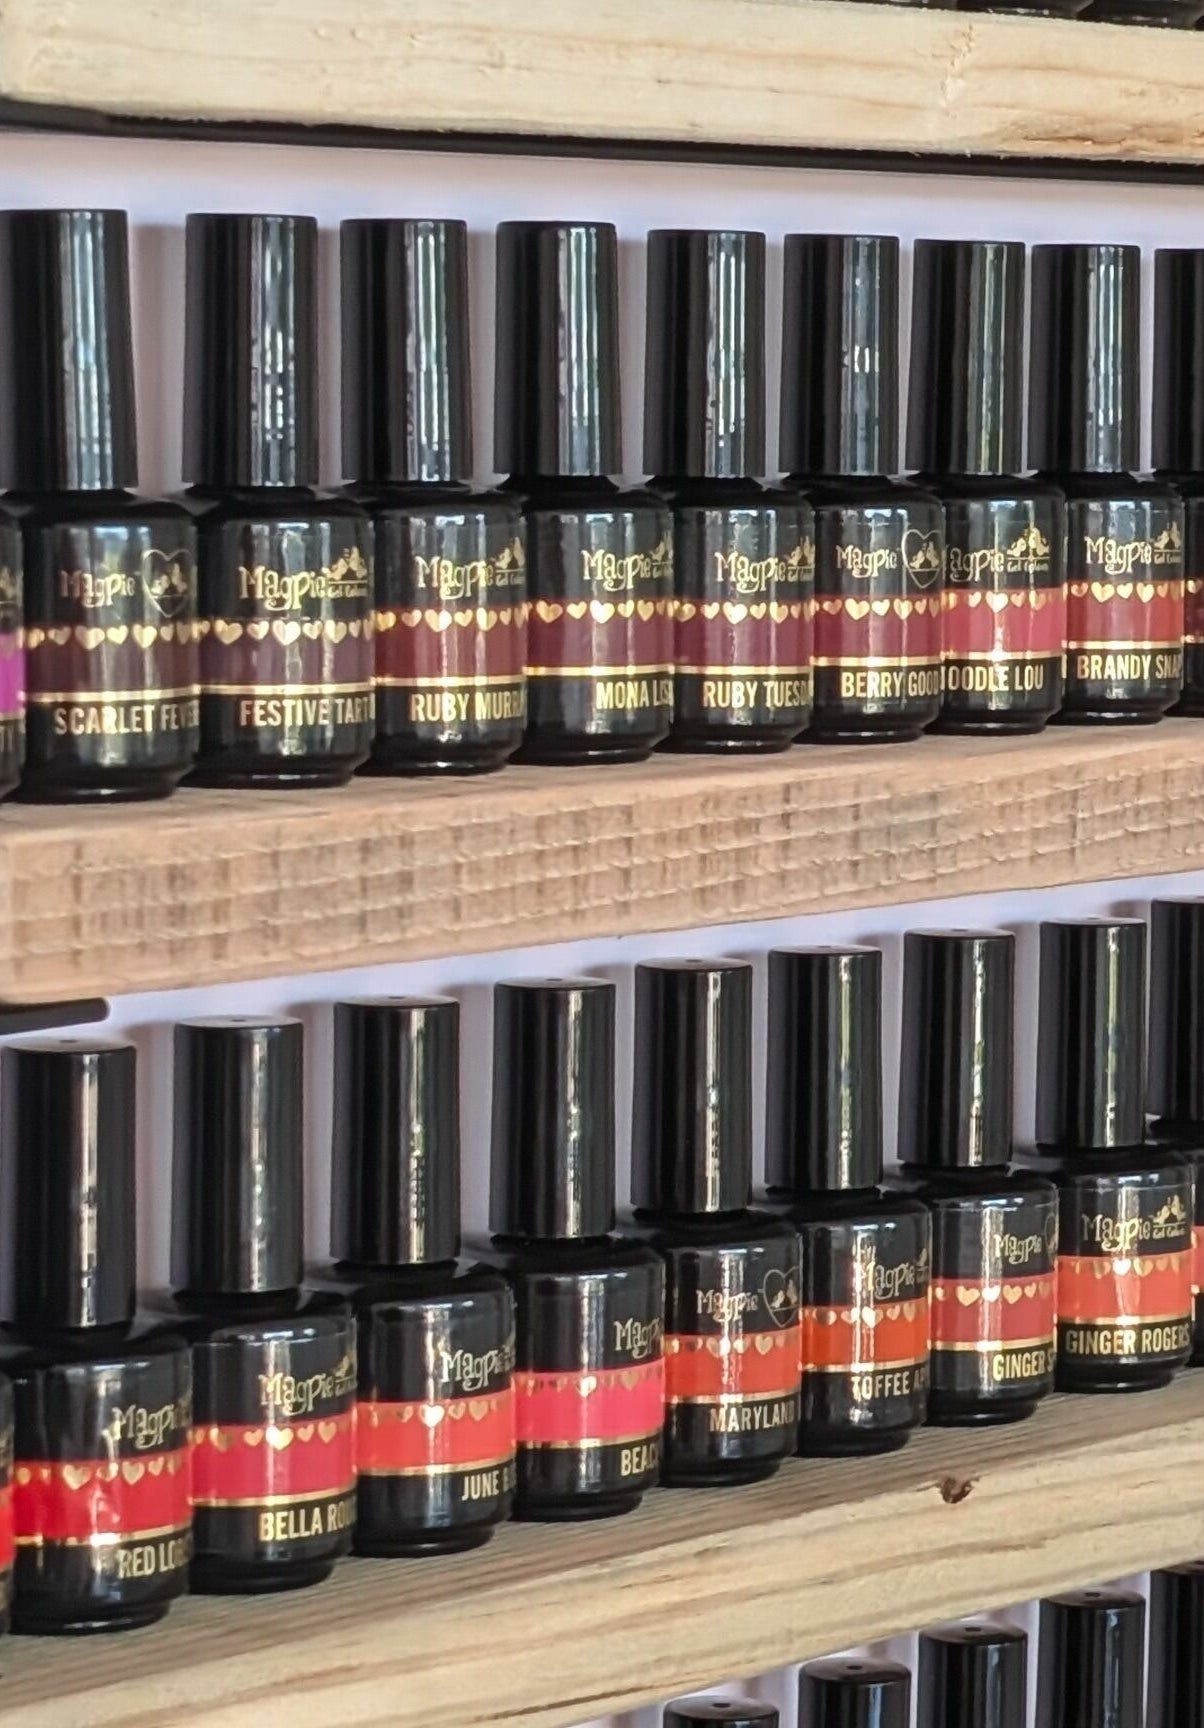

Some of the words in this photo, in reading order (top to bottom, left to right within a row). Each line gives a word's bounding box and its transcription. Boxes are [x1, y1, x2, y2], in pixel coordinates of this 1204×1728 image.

[581, 549, 651, 592] Magpie
[836, 544, 898, 579] Magpie
[1084, 535, 1152, 576] Magpie
[60, 570, 135, 608] Magpie
[238, 565, 327, 610] Magpie
[415, 556, 494, 600] Magpie
[714, 551, 786, 594] Magpie
[1014, 664, 1044, 691] LOU
[1077, 655, 1151, 680] BRANDY
[596, 680, 650, 710] MONA
[703, 680, 759, 709] RUBY
[841, 671, 904, 698] BERRY
[907, 671, 940, 699] GOOD
[54, 702, 155, 736] SCARLET
[239, 698, 330, 727] FESTIVE
[411, 692, 470, 722] RUBY
[993, 1233, 1042, 1265] Magpie
[1081, 1213, 1151, 1252] Magpie
[696, 1288, 758, 1323] Magpie
[1065, 1329, 1137, 1355] GINGER
[1141, 1326, 1191, 1353] ROGERS
[992, 1352, 1046, 1381] GINGER
[257, 1372, 334, 1416] Magpie
[850, 1370, 911, 1401] TOFFEE
[111, 1404, 180, 1449] Magpi
[710, 1400, 795, 1433] MARYLAND
[461, 1471, 500, 1502] JUNE
[260, 1507, 323, 1542] BELLA
[116, 1547, 156, 1579] RED
